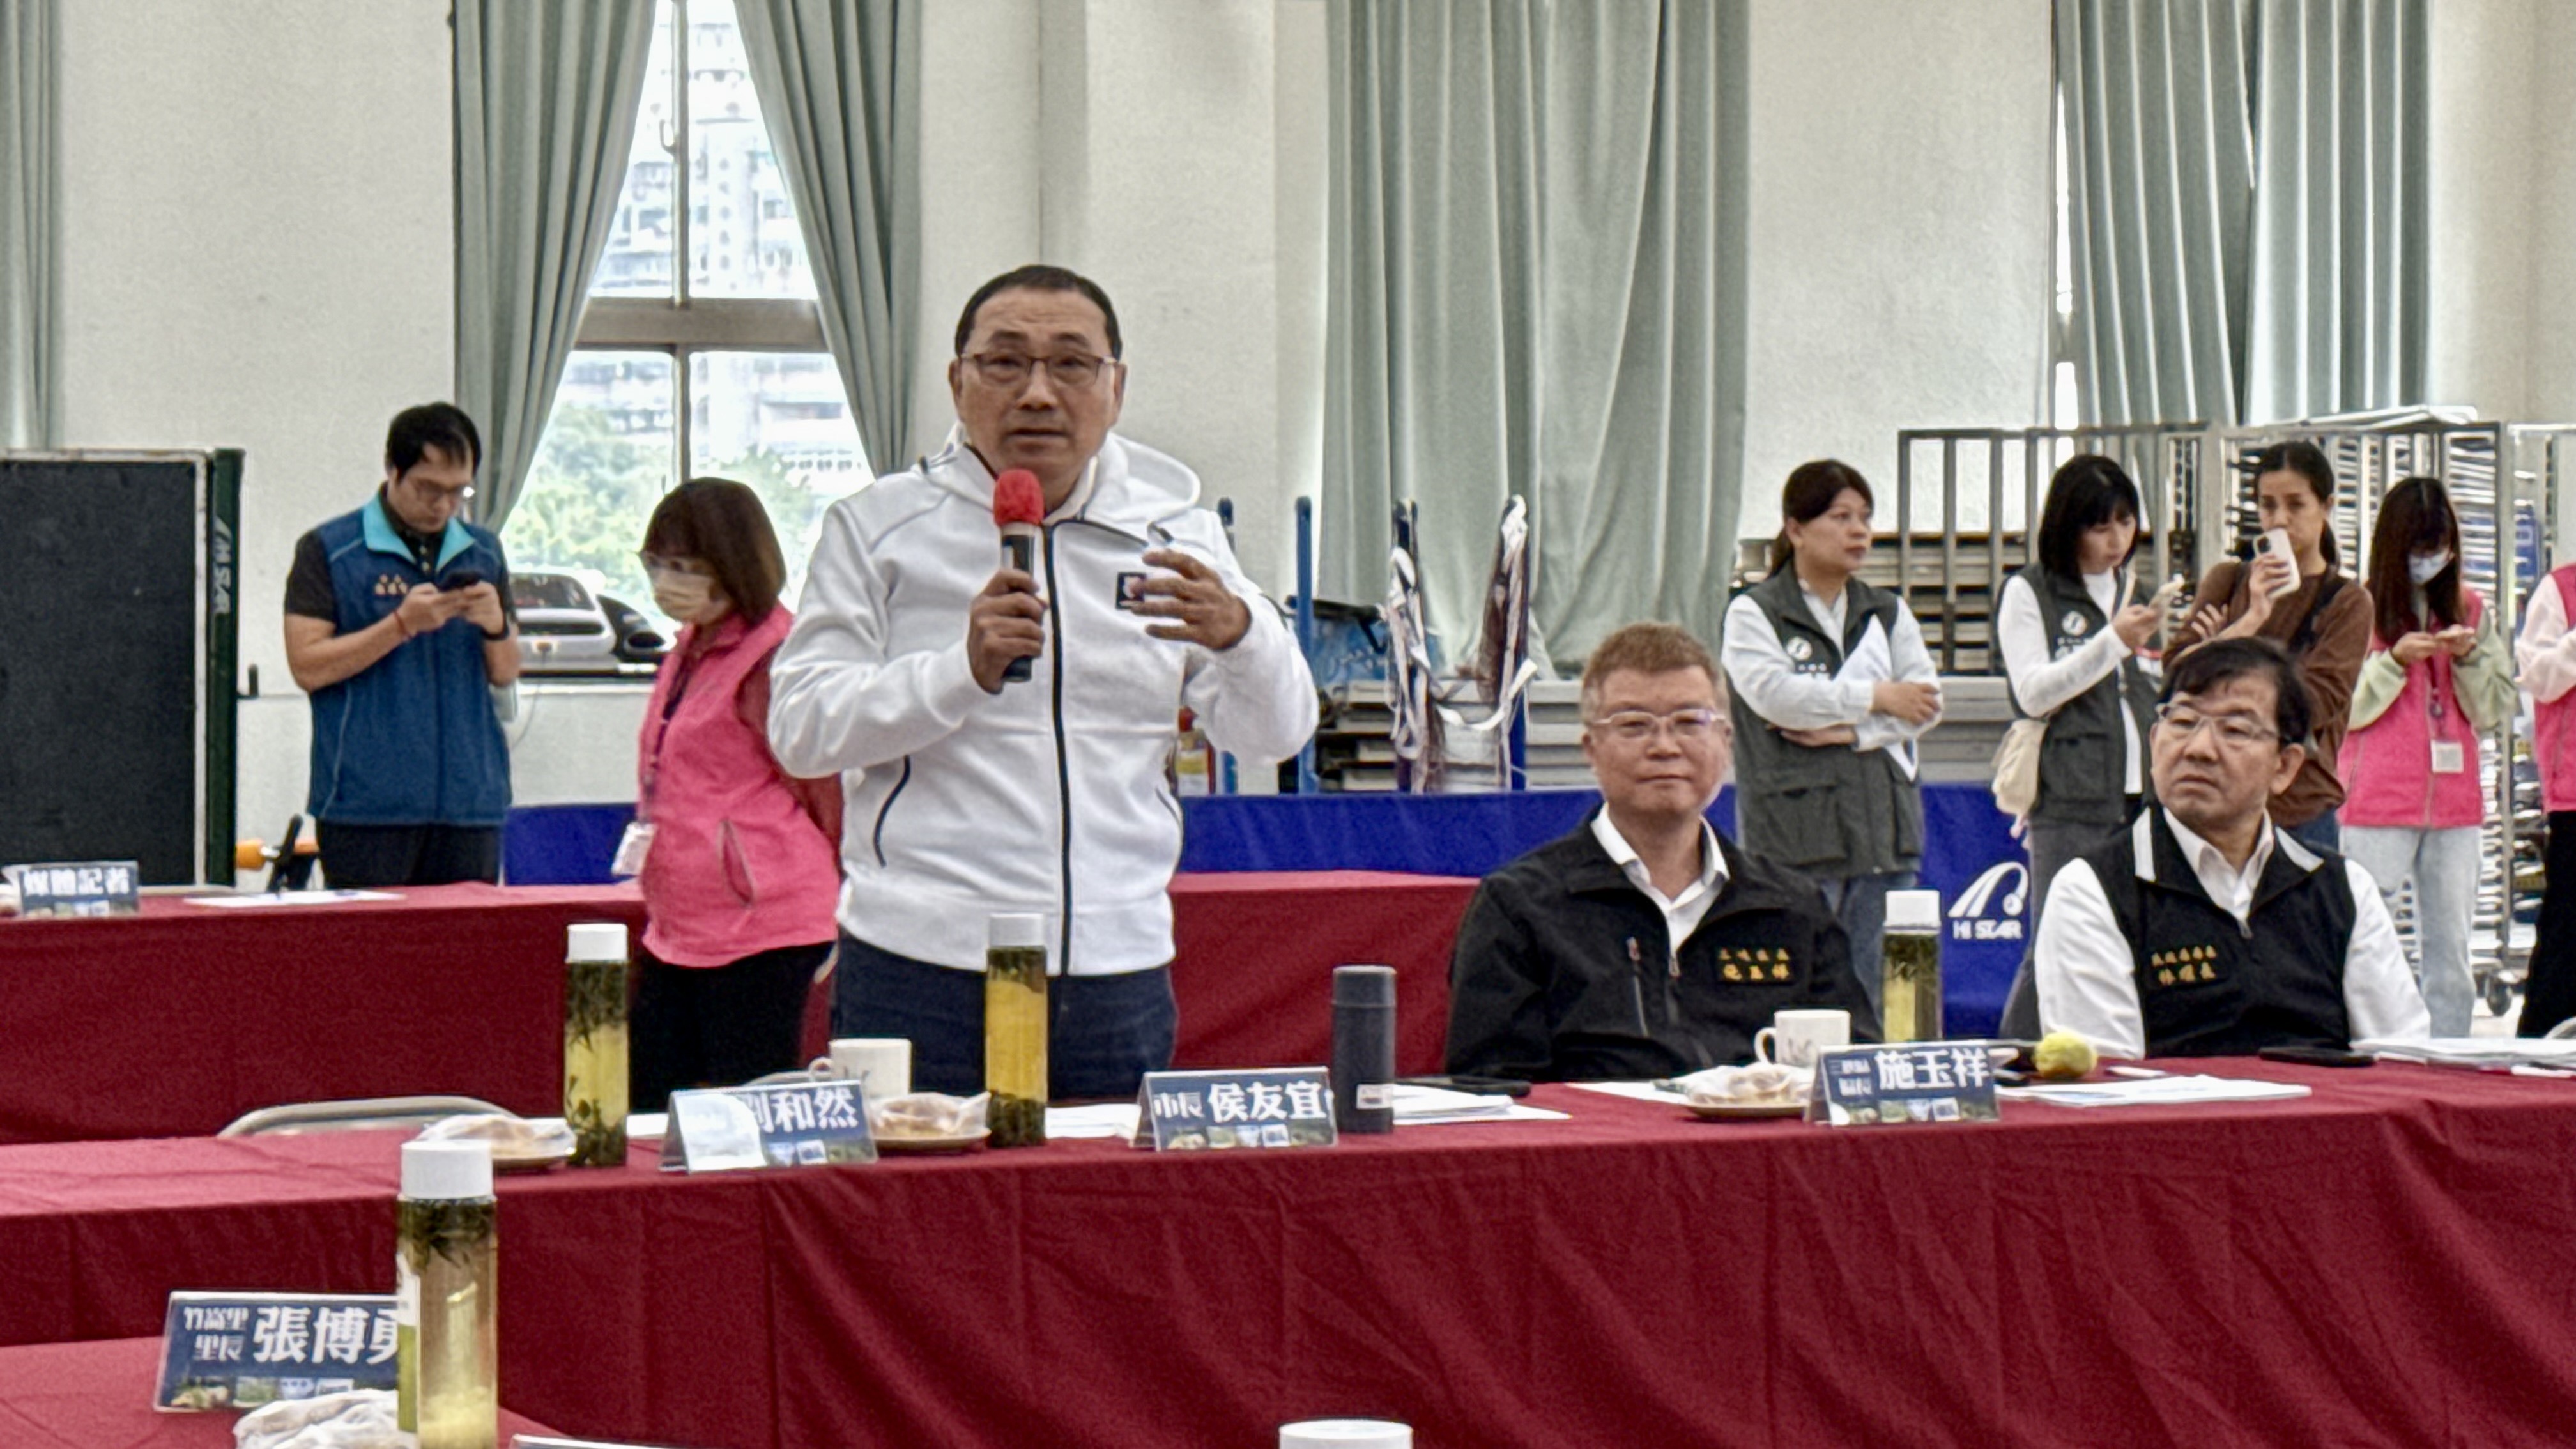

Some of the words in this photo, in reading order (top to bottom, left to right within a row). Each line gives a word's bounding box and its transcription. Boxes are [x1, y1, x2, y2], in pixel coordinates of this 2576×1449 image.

[1874, 1047, 1990, 1091] 施玉祥
[1153, 1091, 1205, 1119] 市長
[1208, 1080, 1328, 1123] 侯友宜
